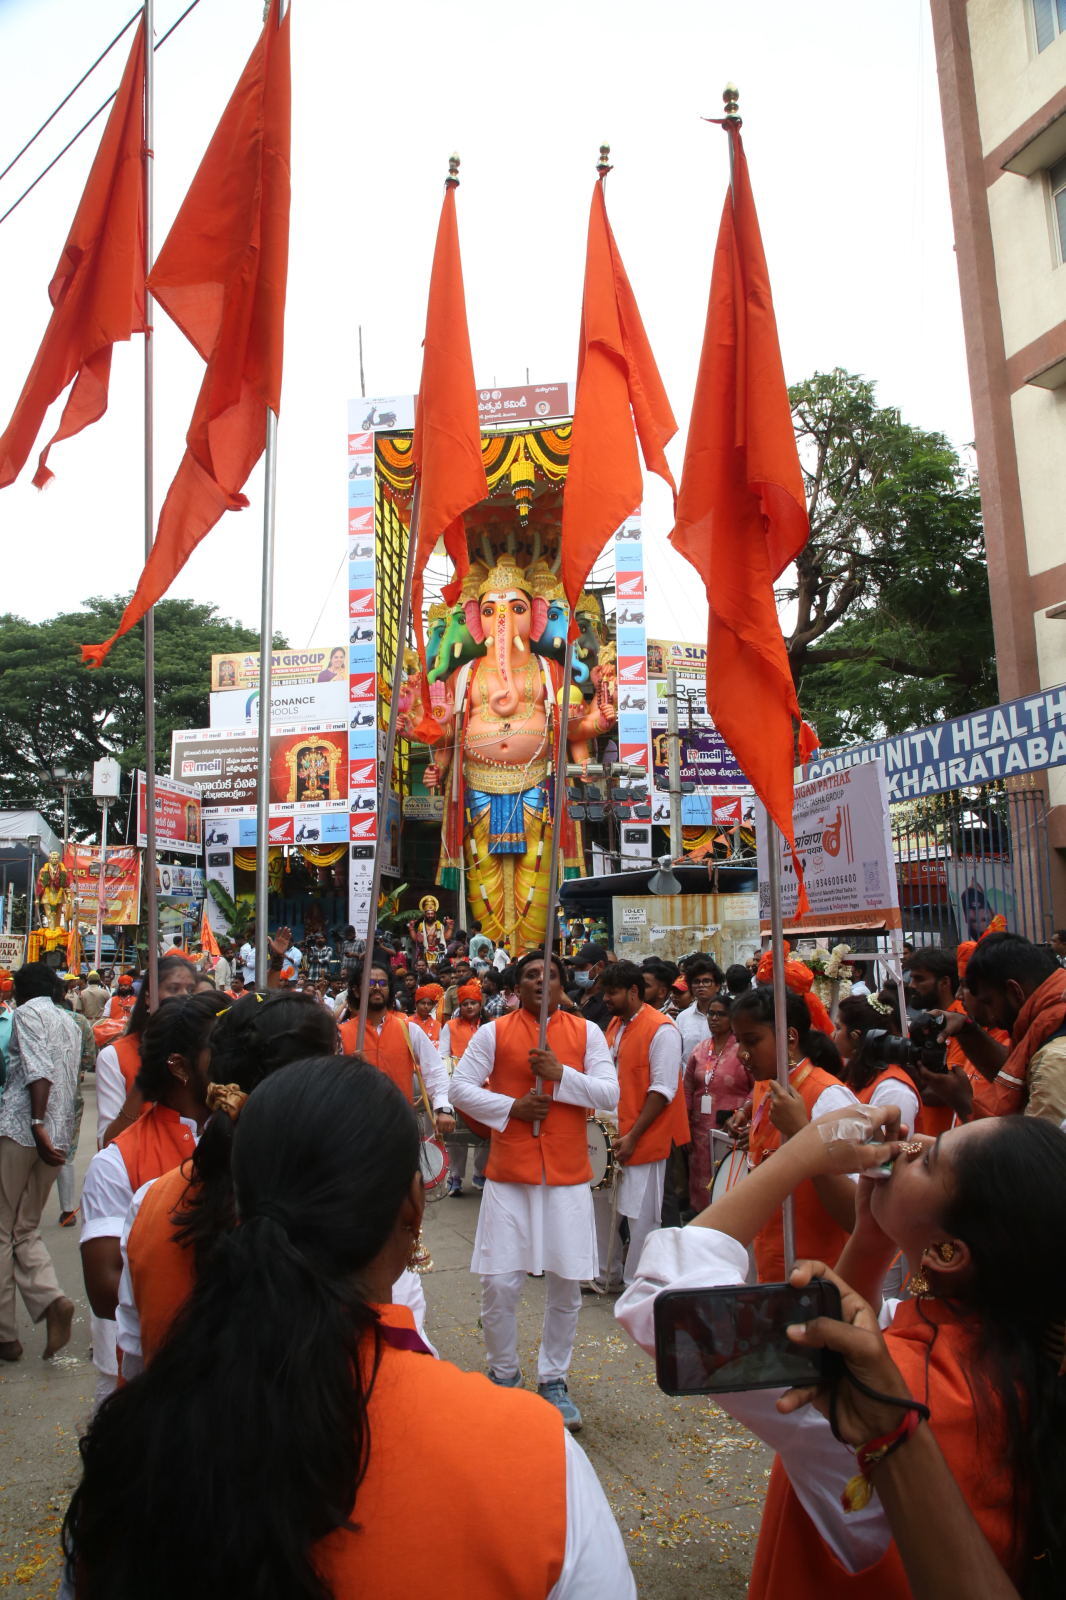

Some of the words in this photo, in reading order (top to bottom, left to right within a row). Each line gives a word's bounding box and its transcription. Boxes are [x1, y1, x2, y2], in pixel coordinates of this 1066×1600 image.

[504, 395, 527, 409] కమిటీ
[685, 647, 707, 659] SLN
[283, 653, 325, 666] GROUP
[256, 696, 316, 707] RSONANCE
[351, 692, 374, 700] HONDA
[951, 690, 1066, 755] HEALTH
[700, 750, 721, 760] meil
[196, 759, 221, 772] meil
[234, 778, 257, 788] చవితి
[351, 776, 376, 784] HONDA
[818, 771, 851, 792] PATHAK
[825, 789, 845, 802] GROUP
